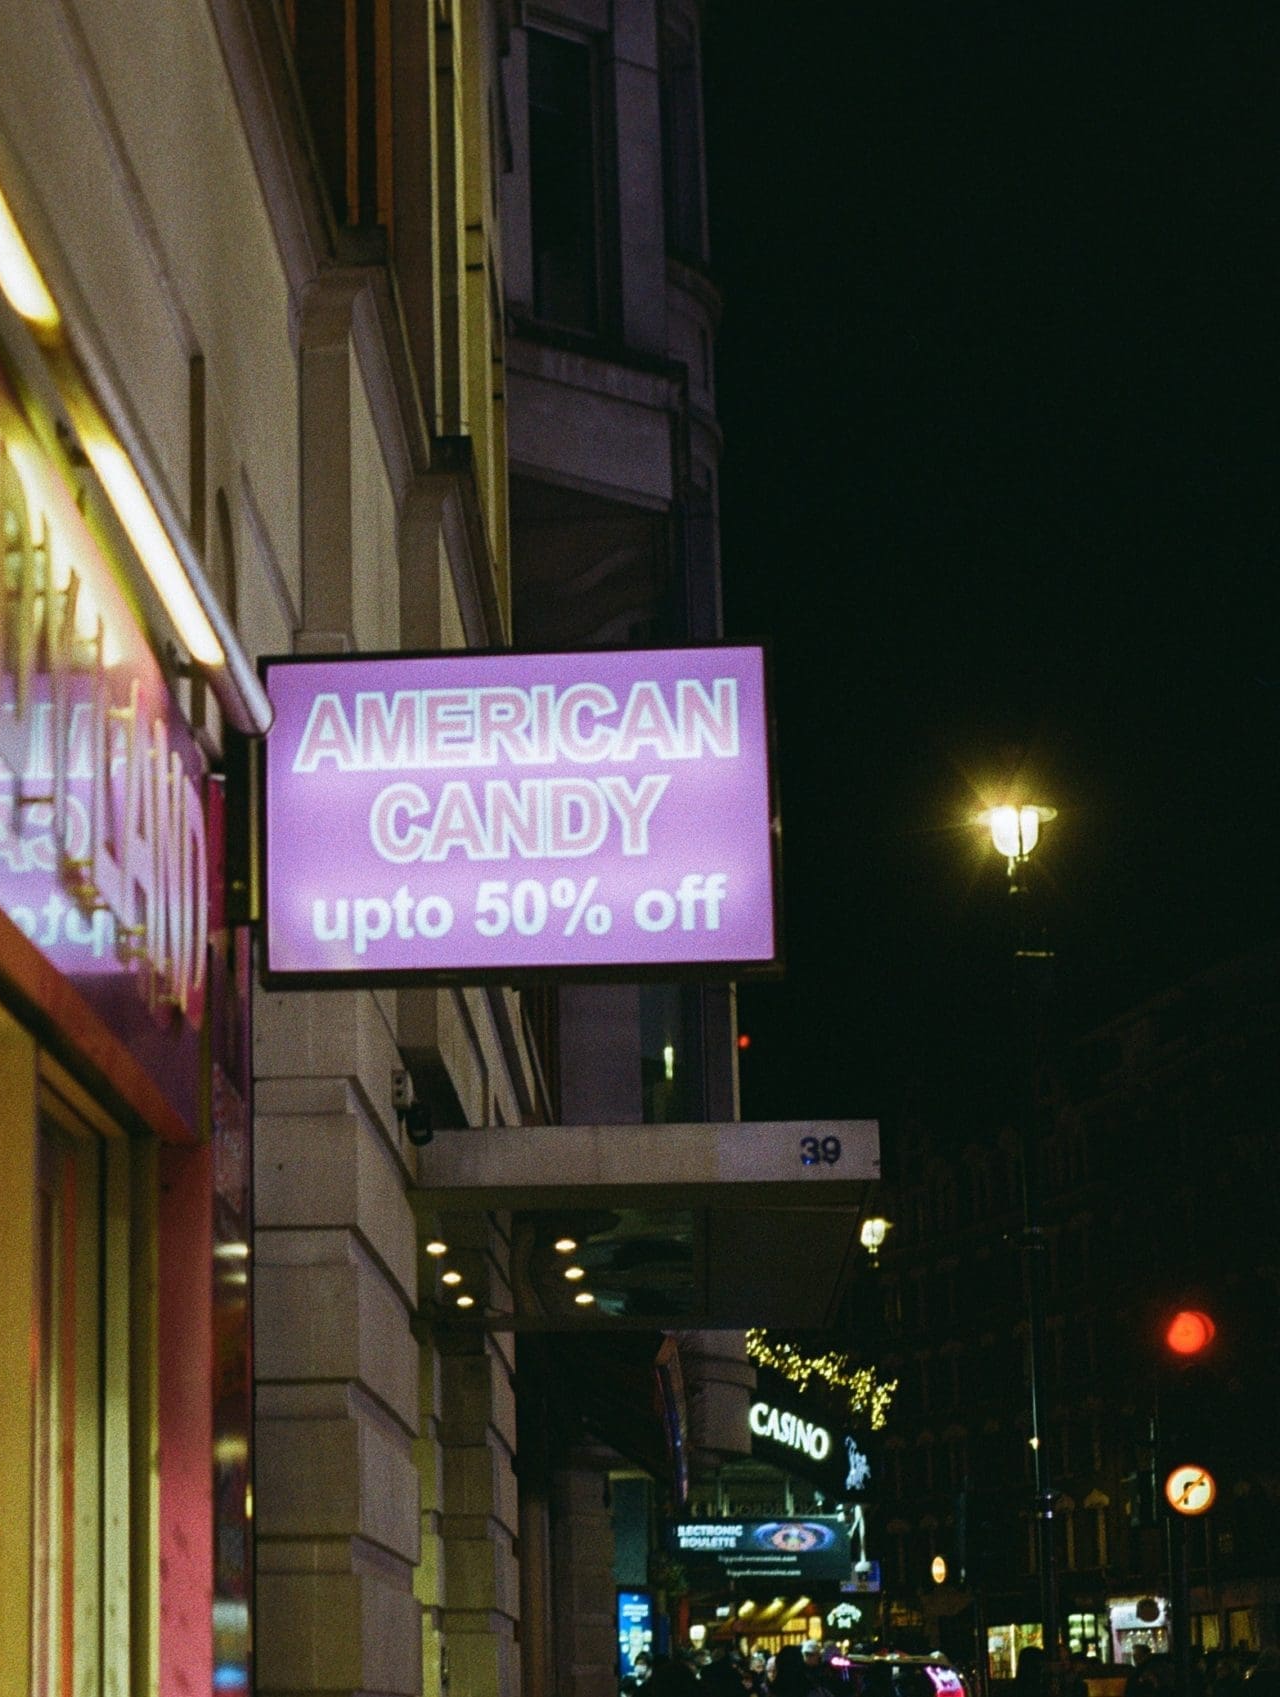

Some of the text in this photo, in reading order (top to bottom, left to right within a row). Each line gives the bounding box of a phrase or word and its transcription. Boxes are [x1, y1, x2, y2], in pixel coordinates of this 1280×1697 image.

[292, 677, 740, 773] AMERICAN
[370, 775, 670, 865] CANDY
[311, 873, 727, 954] upto 50% off
[799, 1135, 842, 1166] 39
[749, 1402, 830, 1460] CASINO
[680, 1537, 736, 1548] ROULETTE
